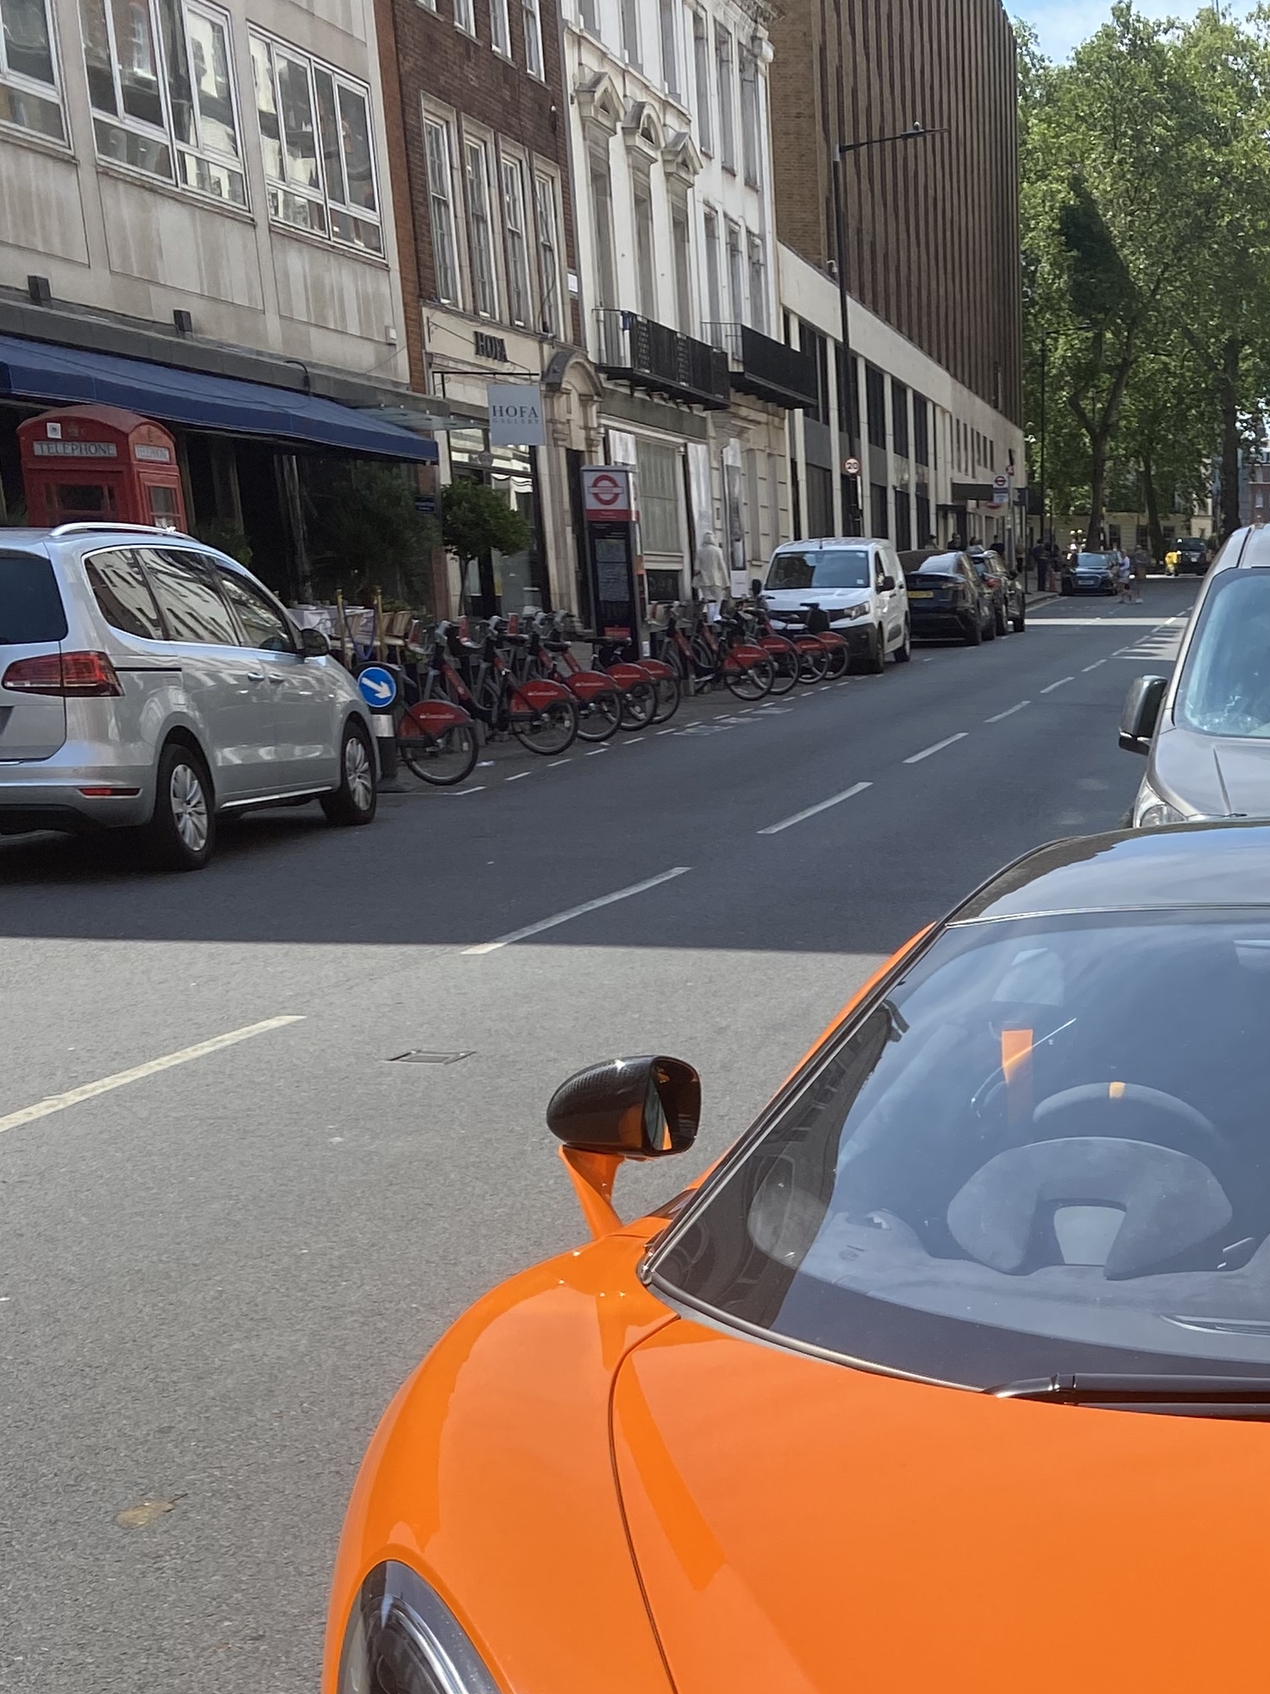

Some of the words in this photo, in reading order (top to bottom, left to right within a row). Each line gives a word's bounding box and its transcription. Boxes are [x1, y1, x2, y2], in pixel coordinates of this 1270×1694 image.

[474, 331, 509, 363] HOFA
[492, 405, 538, 418] HOFA
[38, 441, 116, 455] TELEPHONE
